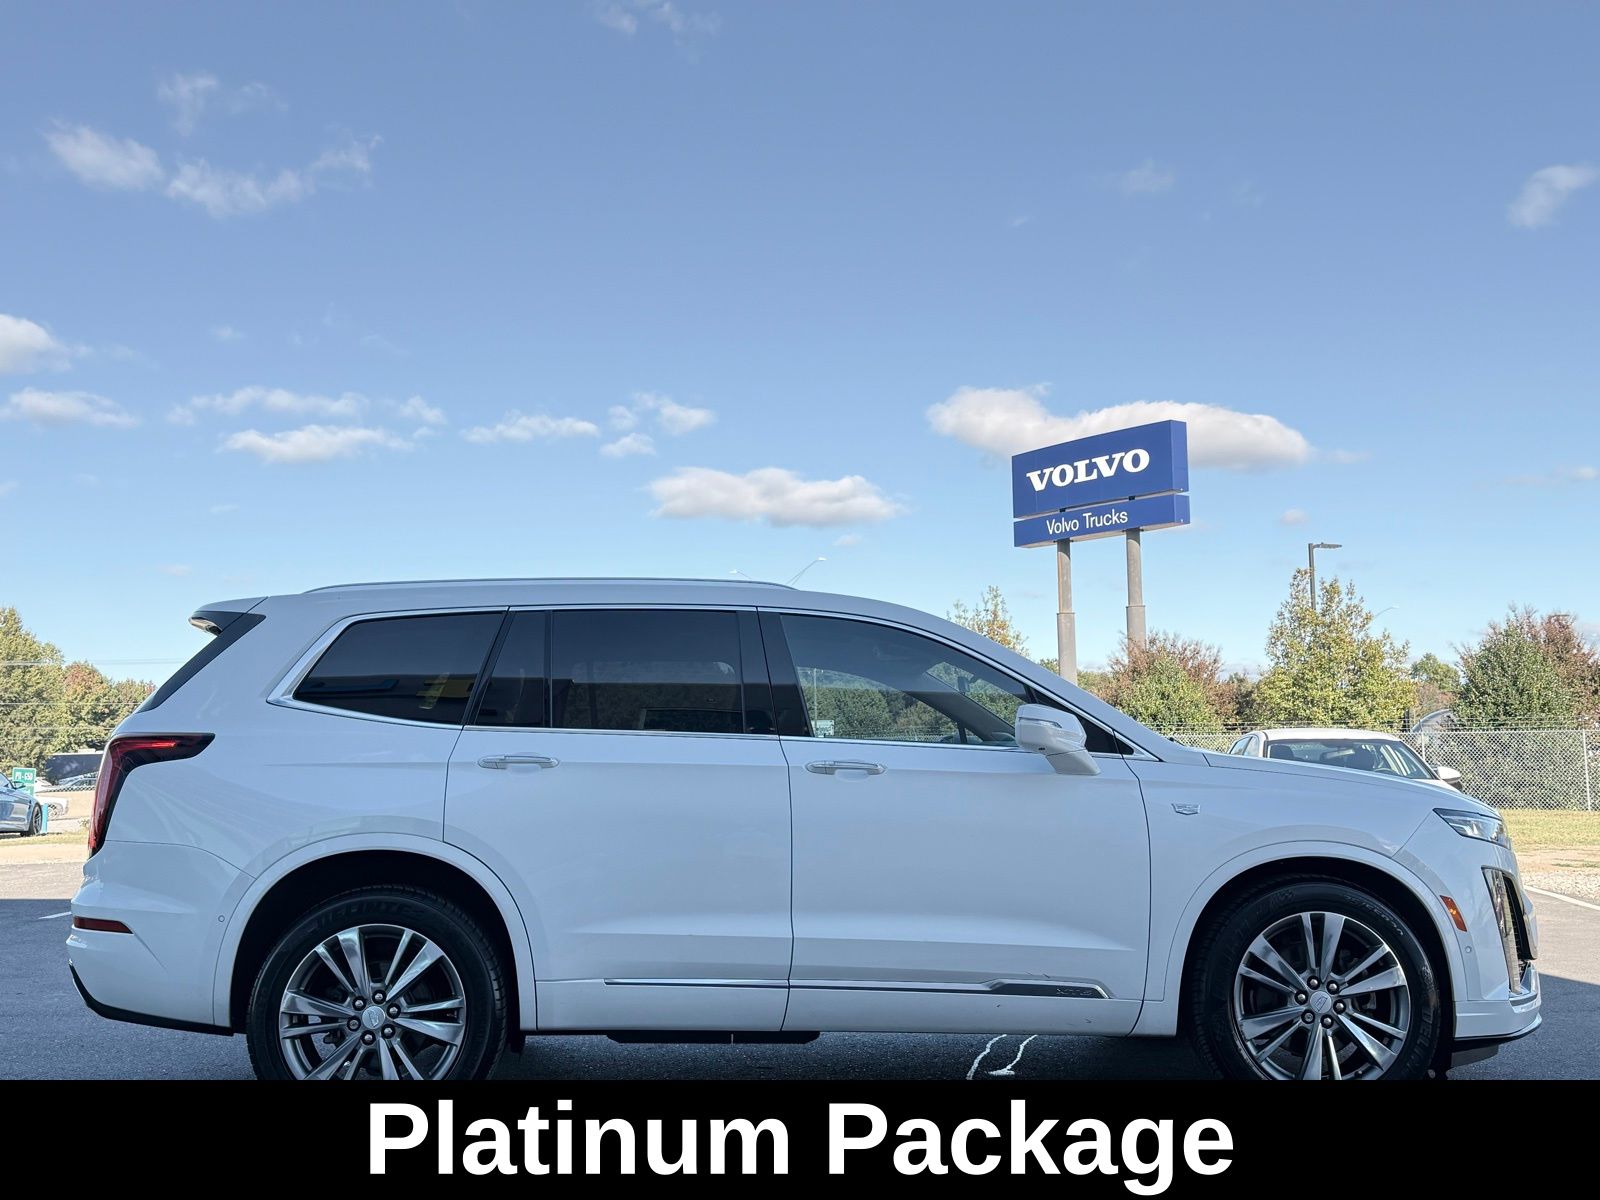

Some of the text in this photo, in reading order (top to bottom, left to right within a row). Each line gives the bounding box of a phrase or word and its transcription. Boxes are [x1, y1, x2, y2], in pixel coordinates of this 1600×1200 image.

[1026, 448, 1150, 492] VOLVO
[1046, 508, 1128, 535] Volvo Trucks
